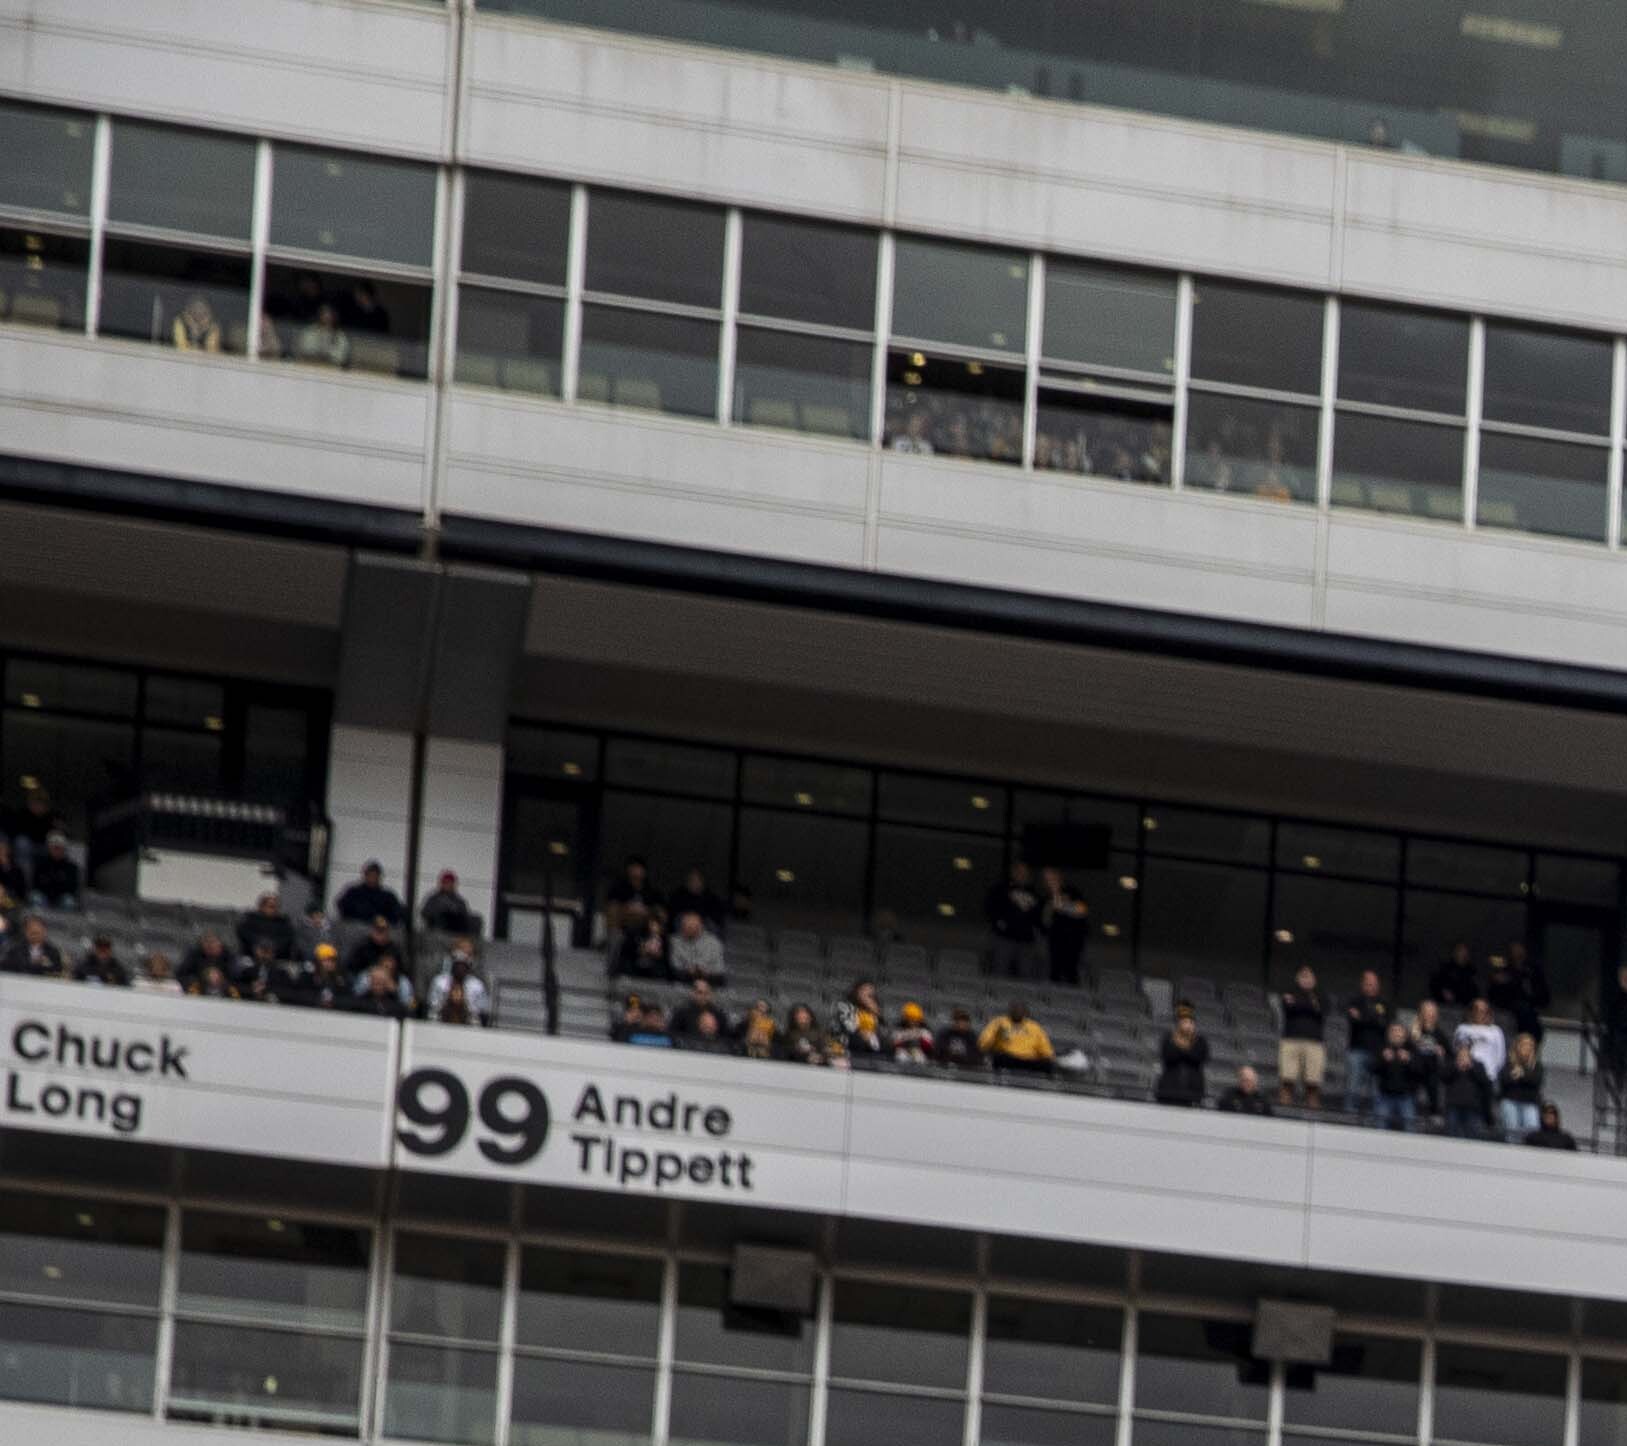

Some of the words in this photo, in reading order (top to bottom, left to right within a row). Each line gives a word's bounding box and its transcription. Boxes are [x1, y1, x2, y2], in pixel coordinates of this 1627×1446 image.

[12, 1019, 190, 1079] Chuck
[5, 1073, 143, 1134] Long
[397, 1068, 551, 1166] 99
[573, 1083, 733, 1137] Andre
[571, 1133, 755, 1191] Tippett
